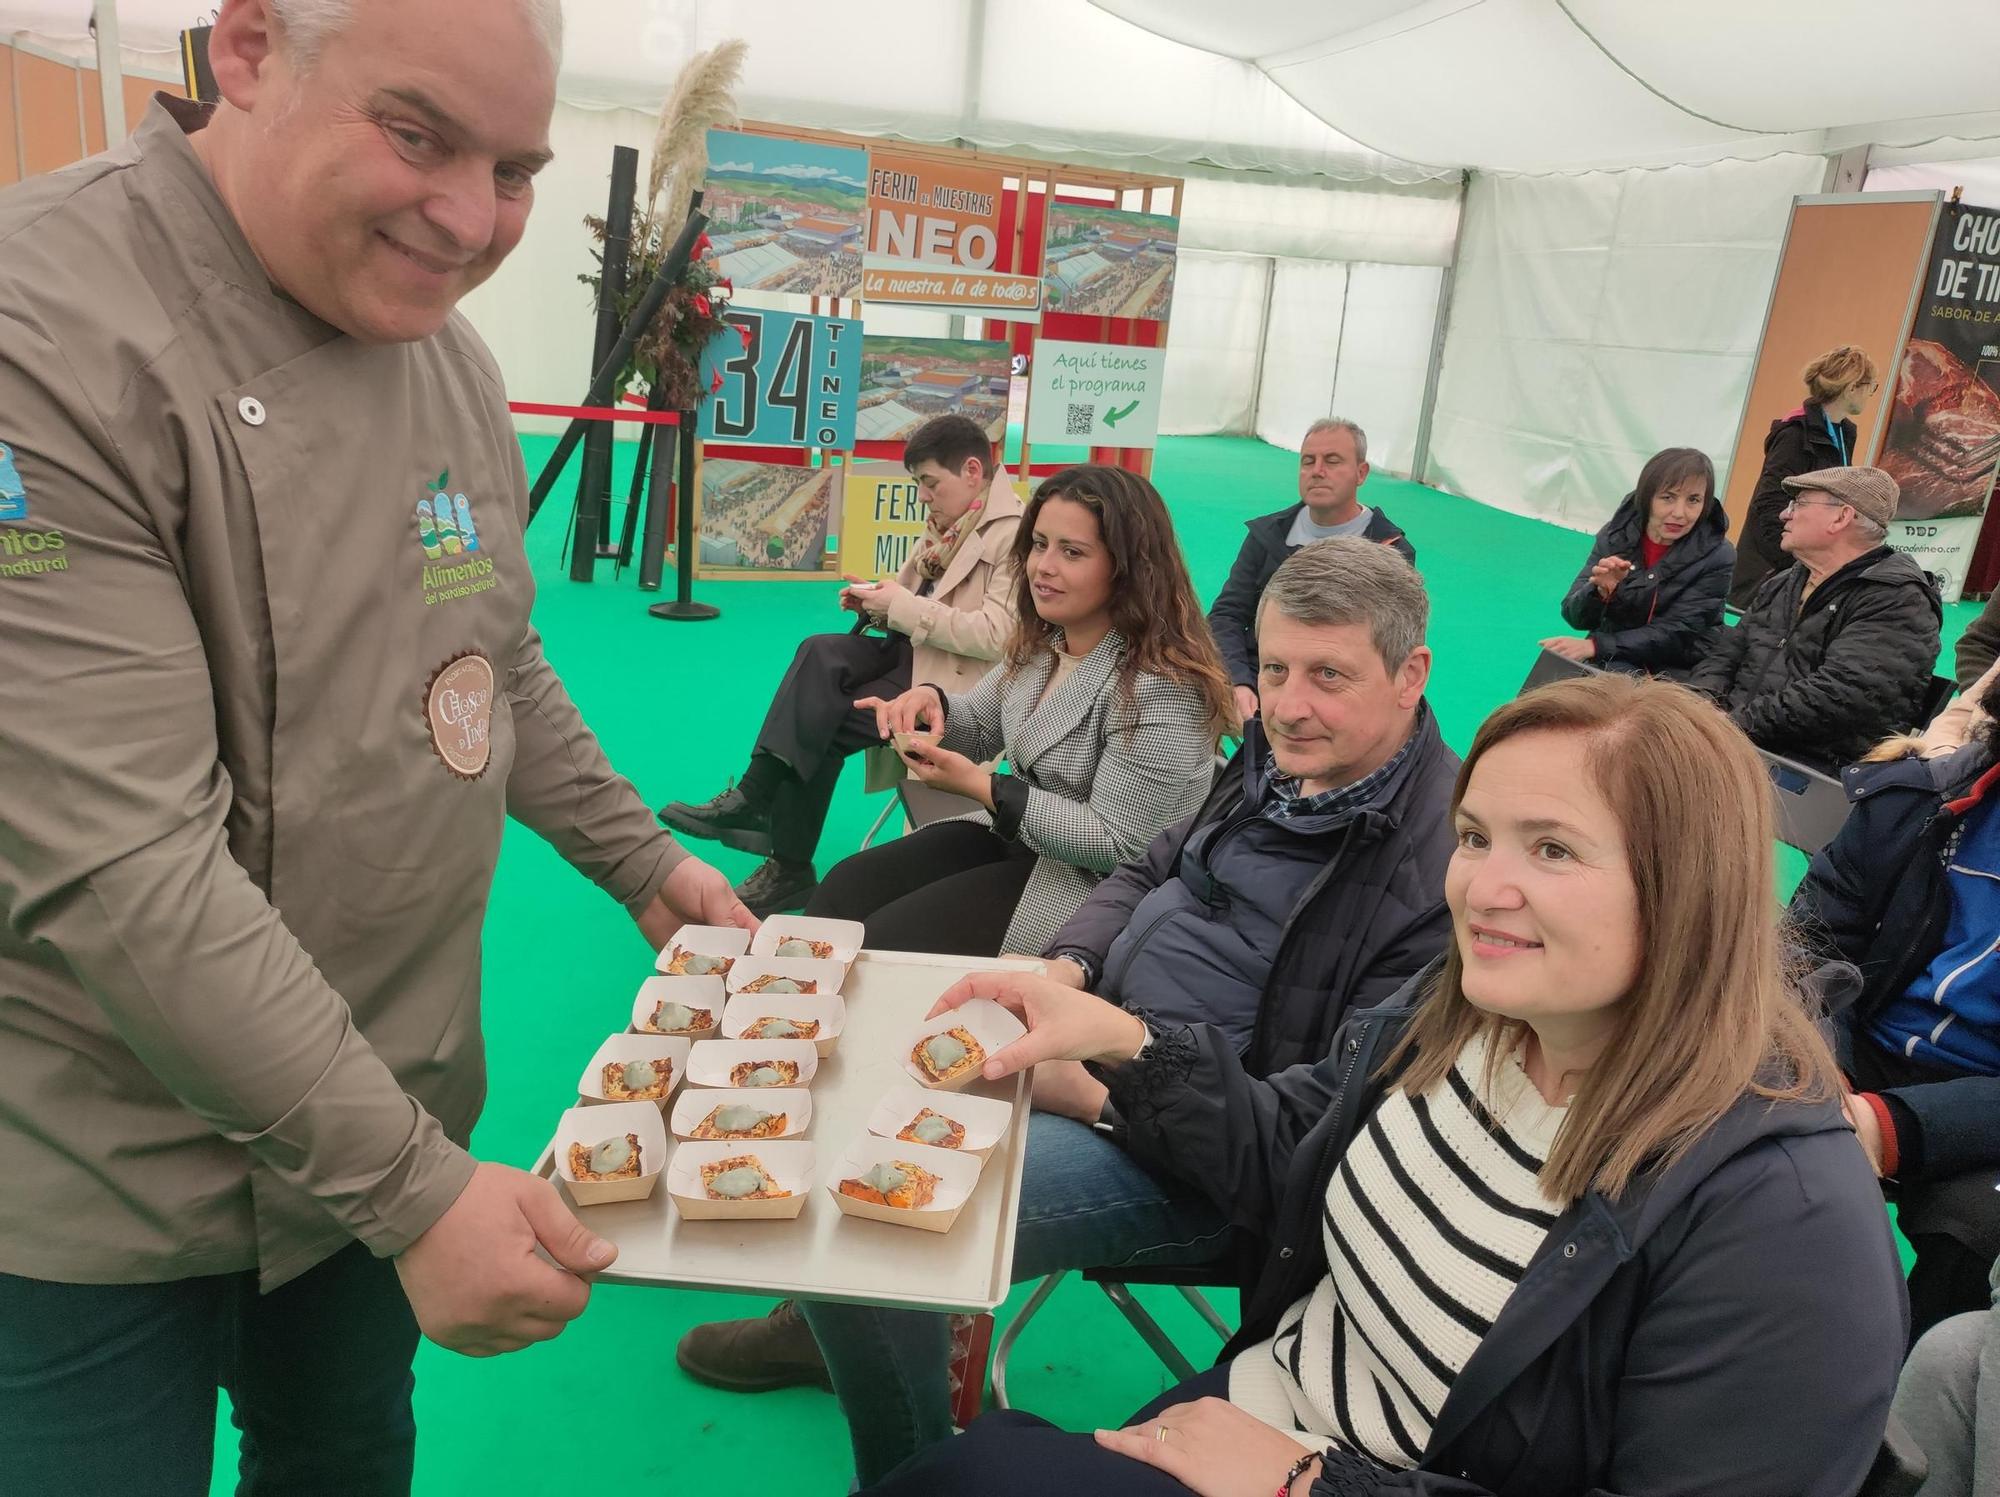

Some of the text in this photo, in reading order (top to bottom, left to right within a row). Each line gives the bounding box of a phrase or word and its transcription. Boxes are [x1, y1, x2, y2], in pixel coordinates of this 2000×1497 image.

[871, 169, 919, 203] FERIA
[932, 186, 993, 217] MUESTRAS
[1953, 212, 2000, 256] CHO
[865, 273, 884, 292] La
[951, 278, 966, 296] la
[970, 280, 988, 298] de
[991, 281, 1036, 301] tod@s
[1936, 259, 2000, 303] DE TI
[1931, 305, 1971, 321] SABOR
[1974, 311, 1991, 323] DE
[713, 310, 816, 443] 34
[1101, 351, 1148, 371] tienes
[817, 323, 846, 447] TINEO
[1051, 375, 1147, 398] el programa
[0, 554, 69, 577] natural
[422, 557, 494, 591] Alimentos
